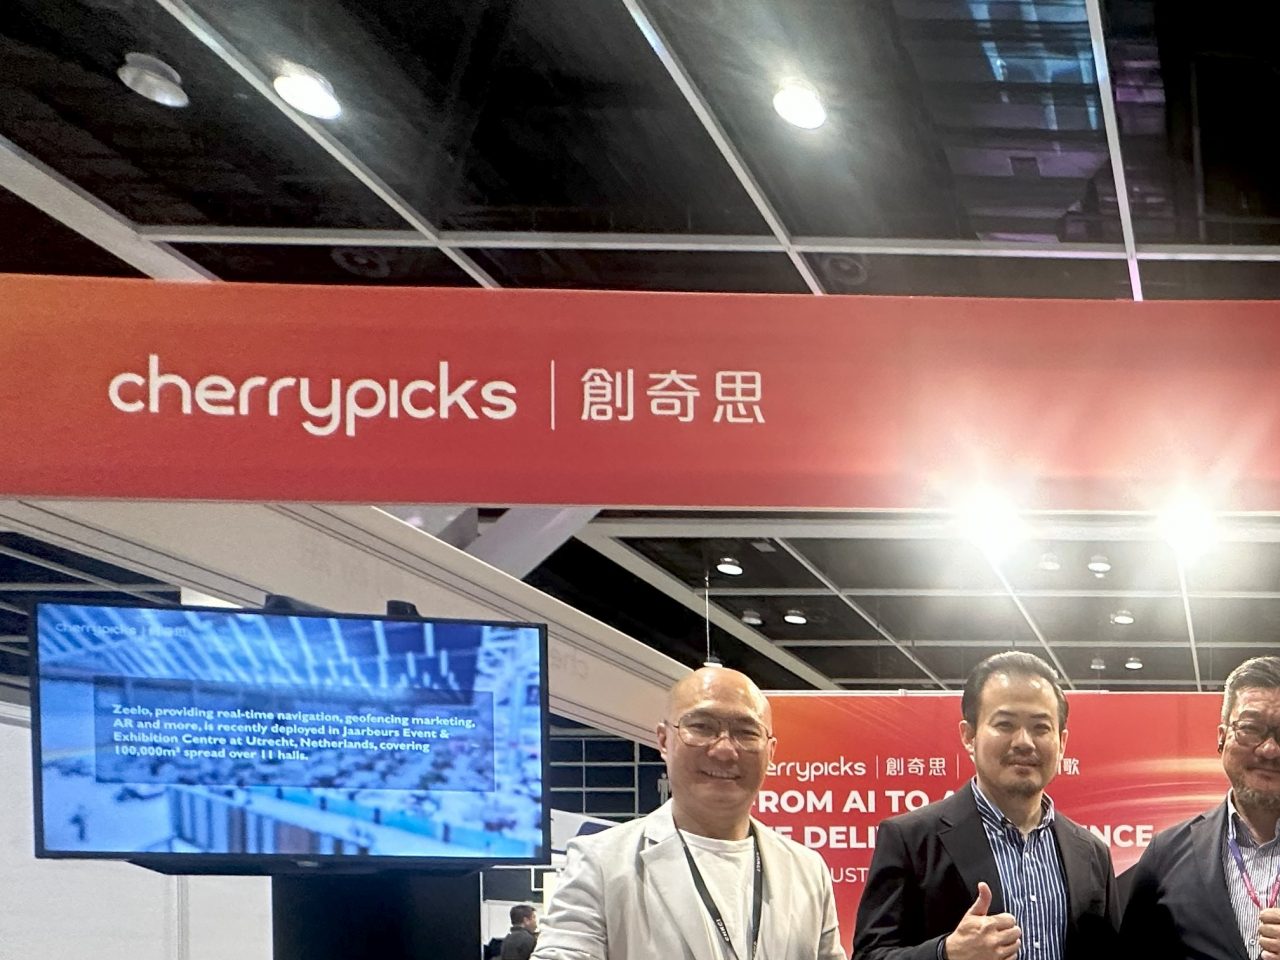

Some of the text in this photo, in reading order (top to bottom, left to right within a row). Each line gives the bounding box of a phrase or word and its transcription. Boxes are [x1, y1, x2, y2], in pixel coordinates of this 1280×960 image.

[108, 354, 518, 437] cherrypicks
[580, 368, 766, 424] 創奇思
[112, 704, 476, 728] Zeelo, providing real-time navigation, geofencing marketing,
[113, 718, 449, 739] AR and more, is recently deployed in Jaarbeurs Event &
[114, 731, 430, 753] Exhibition Centre at Utrecht, Netherlands, covering
[184, 748, 226, 760] spread
[229, 751, 256, 759] over
[261, 750, 273, 760] 11
[278, 750, 309, 761] halls.
[886, 757, 946, 776] 創奇思
[753, 790, 833, 813] ROM
[842, 790, 875, 813] AI
[885, 790, 930, 813] TO
[804, 826, 879, 849] DELI
[1083, 824, 1154, 848] NCE
